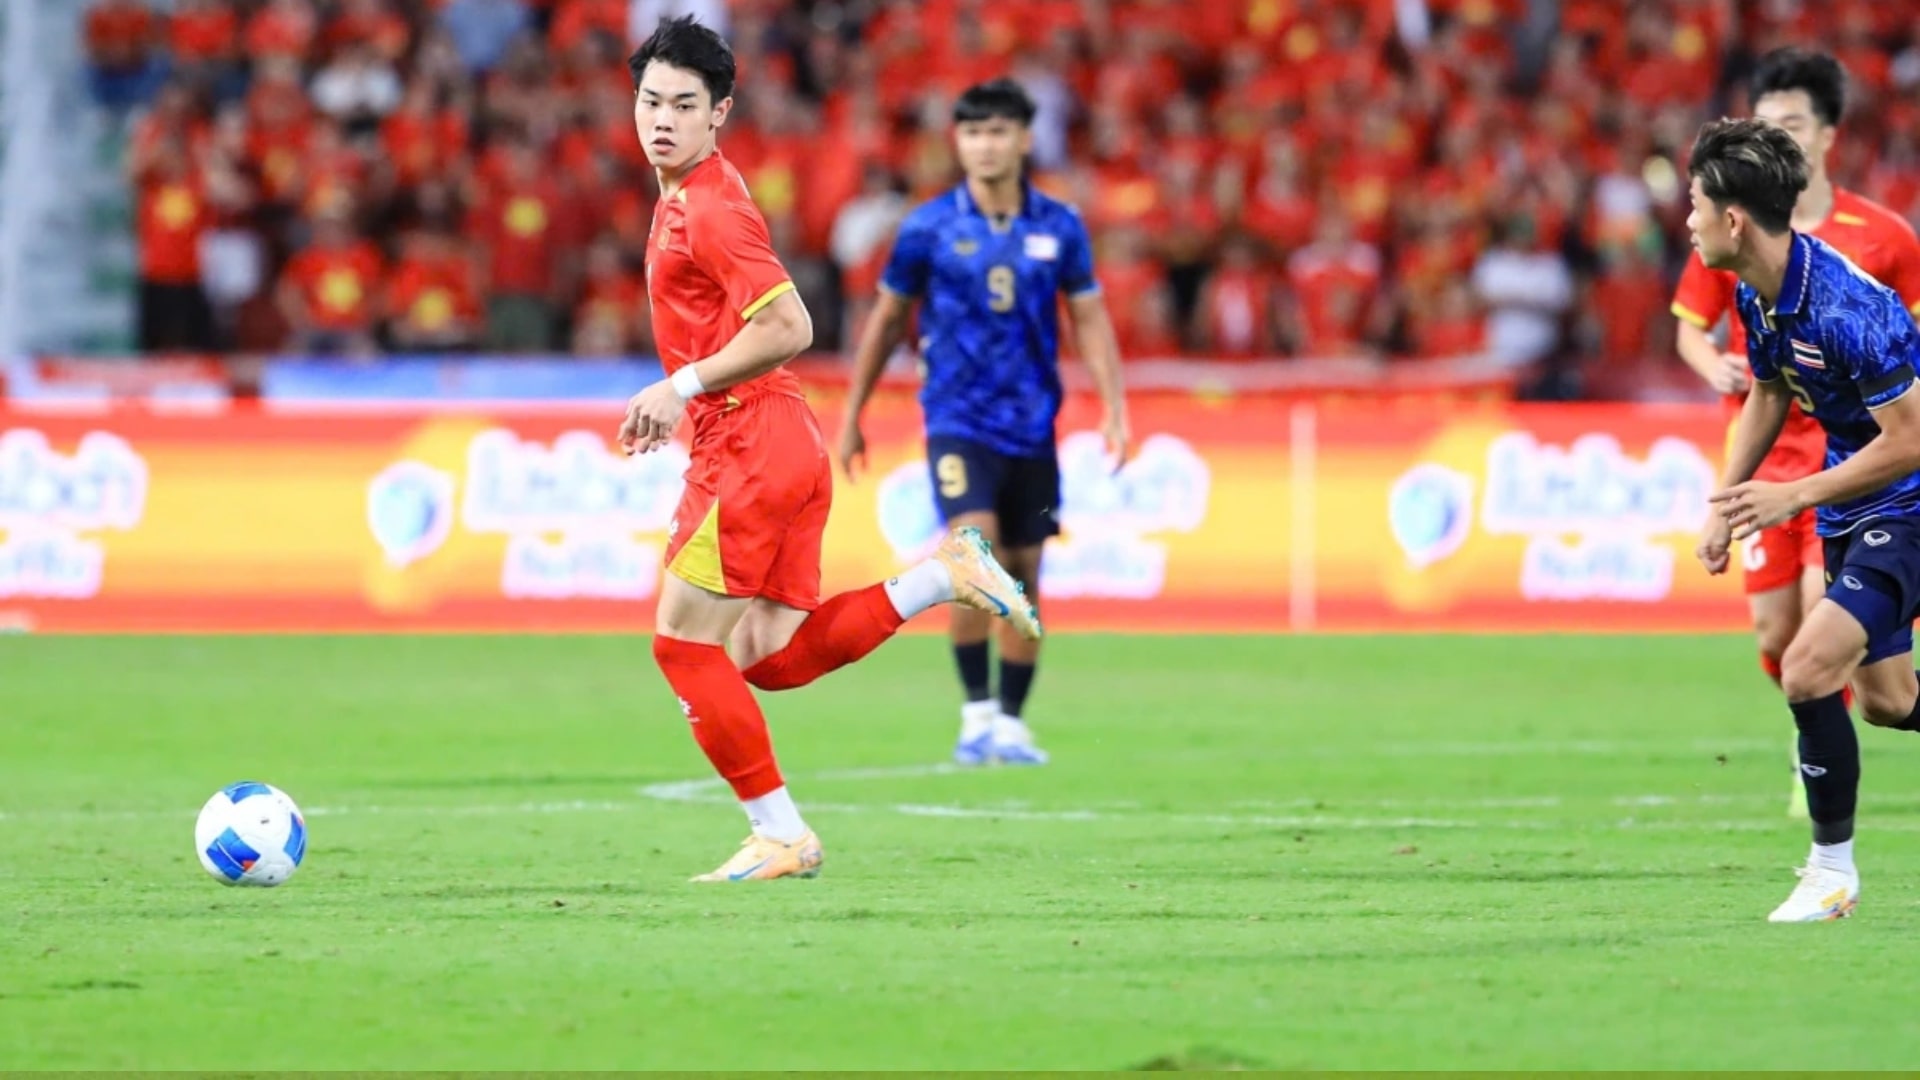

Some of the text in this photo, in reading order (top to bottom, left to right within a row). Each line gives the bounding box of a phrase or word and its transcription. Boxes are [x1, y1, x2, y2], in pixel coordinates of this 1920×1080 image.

[987, 265, 1015, 313] 9
[1781, 366, 1815, 413] 5
[936, 453, 968, 498] 9
